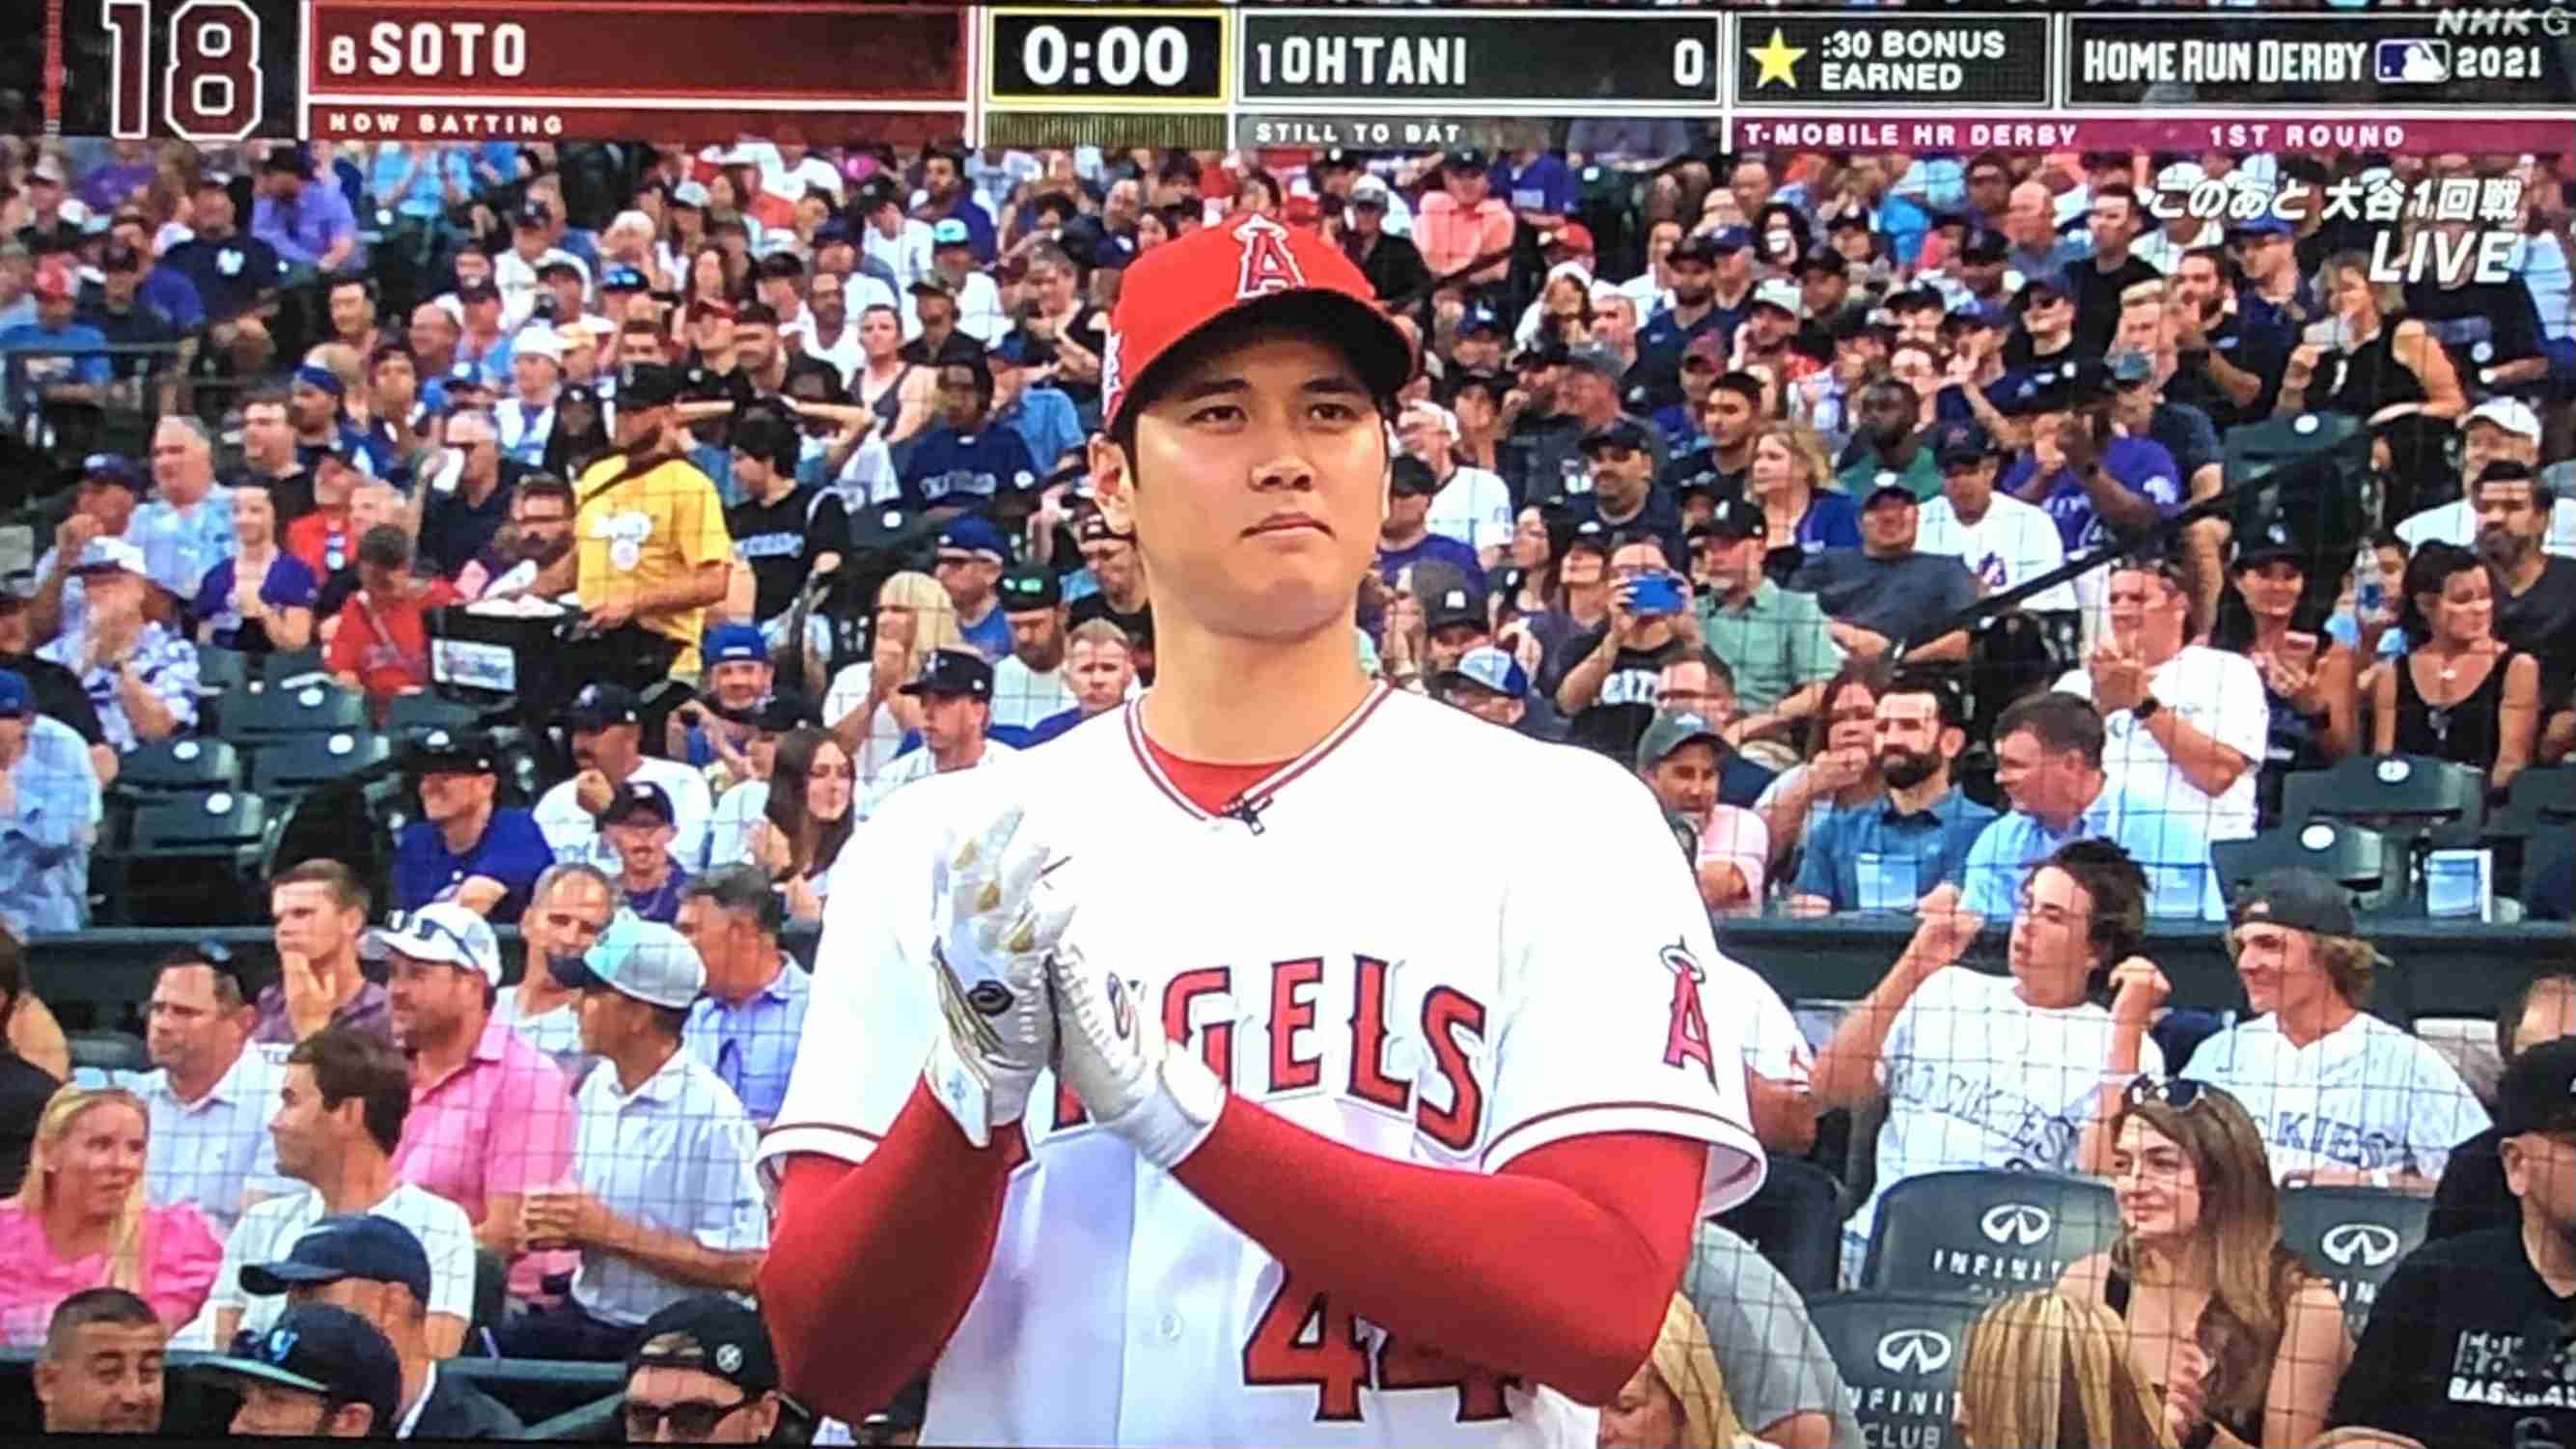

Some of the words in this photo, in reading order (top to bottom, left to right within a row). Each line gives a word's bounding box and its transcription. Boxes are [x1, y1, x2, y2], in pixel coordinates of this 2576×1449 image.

[2434, 9, 2533, 36] NHK
[329, 36, 357, 75] 8
[369, 22, 527, 76] SOTO
[1023, 26, 1189, 85] 0:00
[1281, 36, 1466, 85] OHTANI
[1673, 39, 1705, 87] 0
[1821, 30, 1871, 58] :30
[1882, 30, 2006, 59] BONUS
[2084, 40, 2175, 82] HOME
[2182, 40, 2250, 83] RUN
[2258, 40, 2368, 83] DERBY
[2455, 45, 2542, 78] 2021
[103, 0, 262, 140] 18
[1820, 63, 1963, 91] EARNED
[329, 113, 401, 132] NOW
[419, 113, 564, 135] BATTING
[1256, 124, 1338, 142] STILL
[1355, 124, 1390, 143] TO
[1405, 124, 1460, 143] BAT
[1744, 124, 1899, 145] T-MOBILE
[1912, 124, 1956, 146] HR
[1971, 124, 2077, 146] DERBY
[2210, 125, 2269, 146] 1ST
[2285, 125, 2404, 146] ROUND
[2149, 178, 2311, 220] このあと
[2321, 177, 2522, 221] 大谷1回戦
[2368, 230, 2518, 283] LIVE
[1660, 933, 1720, 1097] A
[1050, 954, 1487, 1152] GELS
[1933, 1248, 2063, 1281] INFINI
